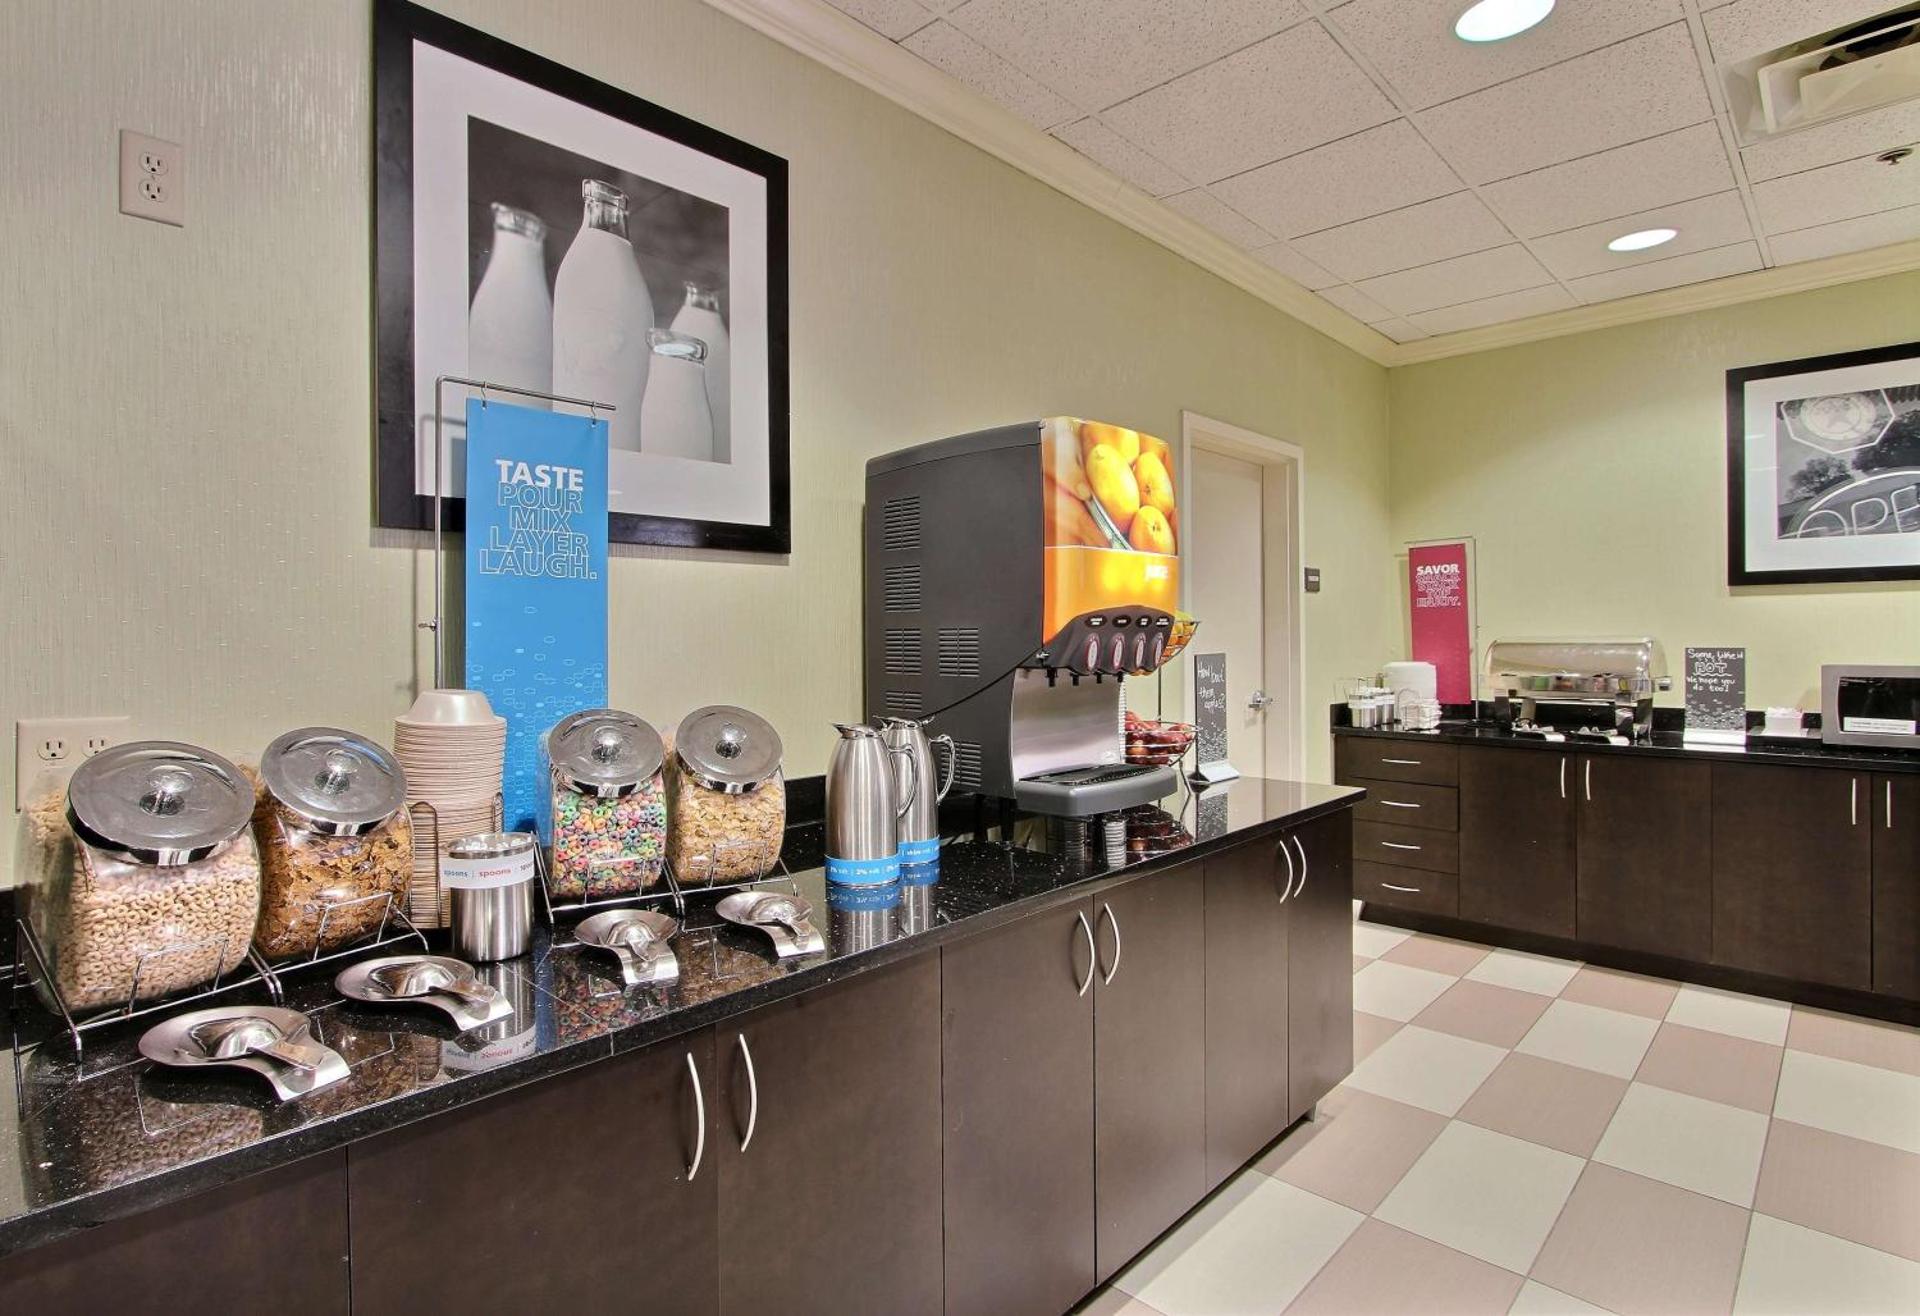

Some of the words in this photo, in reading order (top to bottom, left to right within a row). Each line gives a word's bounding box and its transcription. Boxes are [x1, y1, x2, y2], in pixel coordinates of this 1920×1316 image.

[495, 459, 584, 492] TASTE
[497, 482, 583, 514] POUR
[510, 505, 572, 533] MIX
[490, 526, 589, 556] LAYER
[479, 549, 598, 579] LAUGH.
[1416, 564, 1460, 575] SAVOR
[1695, 662, 1727, 673] HOT
[479, 868, 512, 878] spoons
